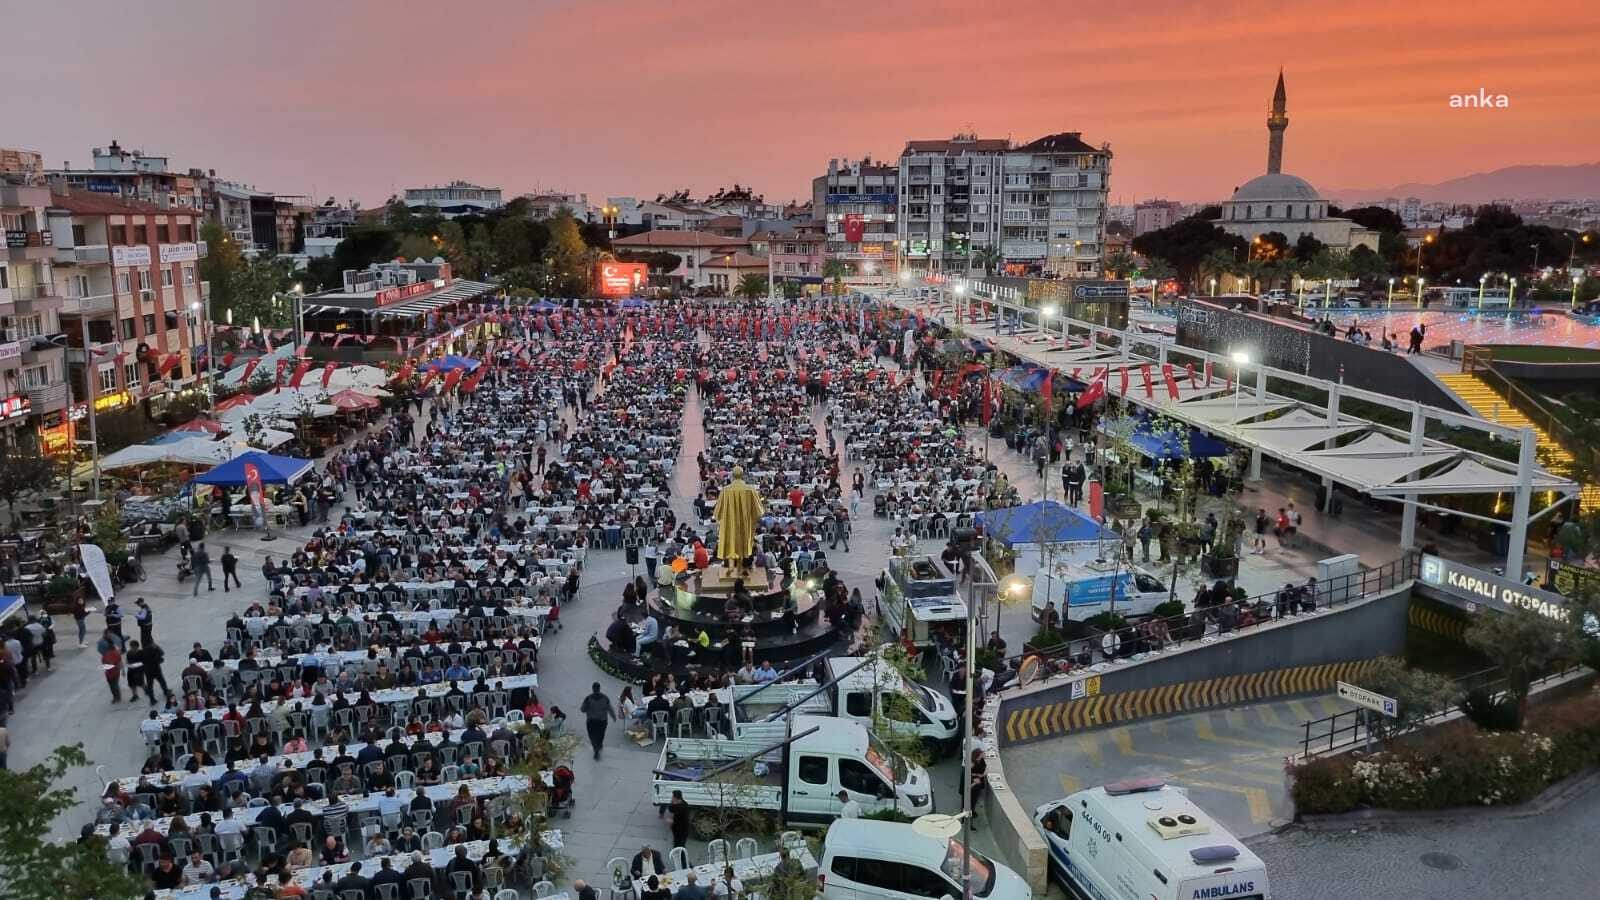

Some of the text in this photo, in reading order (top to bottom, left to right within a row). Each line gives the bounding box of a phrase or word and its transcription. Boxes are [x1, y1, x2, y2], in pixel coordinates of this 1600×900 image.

[1448, 571, 1497, 599] KAPALI
[1349, 691, 1380, 706] OTOPARK
[1081, 810, 1111, 843] 444 40 09
[1192, 881, 1255, 899] AMBULANS
